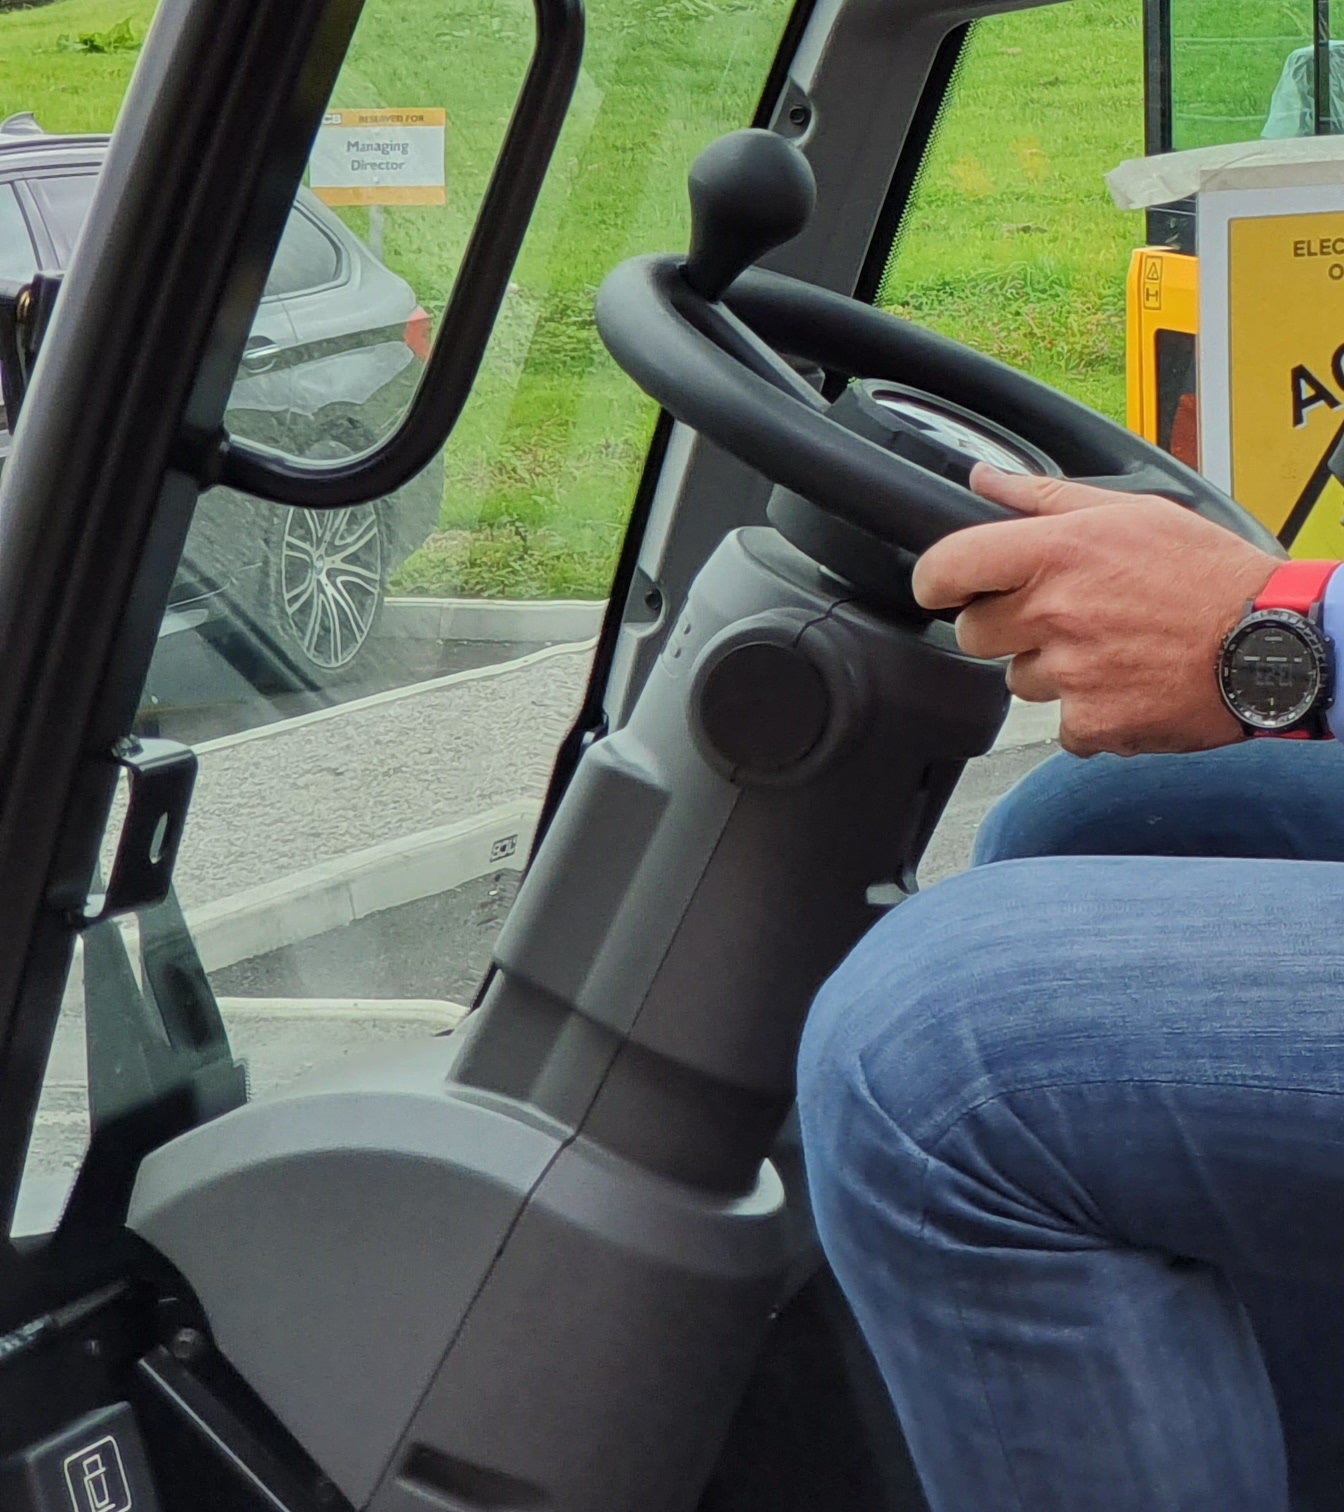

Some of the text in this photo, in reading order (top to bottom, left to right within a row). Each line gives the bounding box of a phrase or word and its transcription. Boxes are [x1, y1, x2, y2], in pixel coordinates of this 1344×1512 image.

[358, 114, 425, 124] RESERVED FOR
[346, 140, 409, 156] Managing
[351, 159, 405, 172] Director
